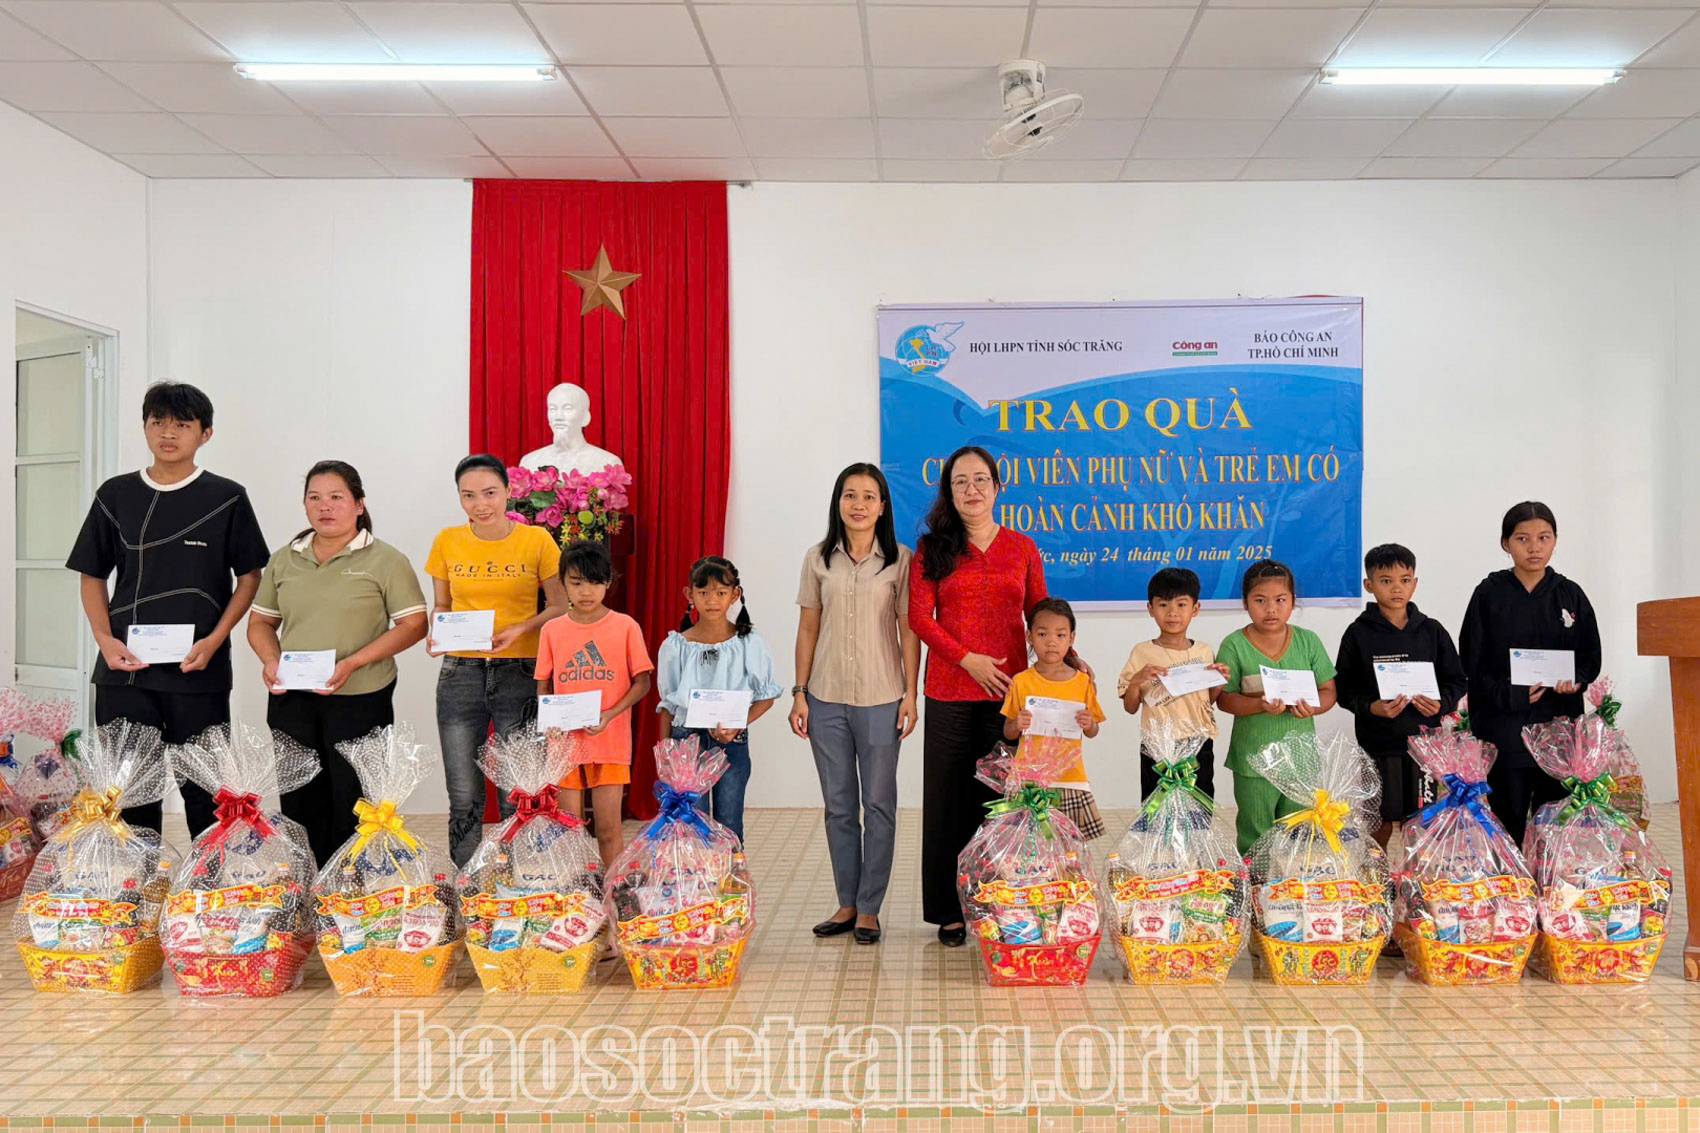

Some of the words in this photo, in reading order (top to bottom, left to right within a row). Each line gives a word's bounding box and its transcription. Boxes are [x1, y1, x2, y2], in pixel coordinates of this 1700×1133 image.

[1254, 330, 1278, 343] BÁO
[1280, 329, 1314, 343] CÔNG
[1316, 331, 1332, 342] AN
[970, 342, 991, 355] HỘI
[993, 342, 1025, 353] LHPN
[1026, 339, 1055, 352] TỈNH
[1058, 338, 1081, 352] SÓC
[1083, 339, 1123, 352] TRĂNG
[1172, 340, 1202, 351] Công
[1204, 341, 1218, 349] an
[1284, 346, 1304, 358] CHÍ
[1307, 347, 1339, 358] MINH
[988, 398, 1130, 432] TRAO
[1145, 387, 1254, 438] QUÀ
[997, 453, 1020, 493] ỘI
[1027, 449, 1081, 486] VIÊN
[1088, 456, 1134, 492] PHỤ
[1139, 449, 1174, 485] NỮ
[1178, 447, 1209, 484] VÀ
[1214, 446, 1260, 484] TRẺ
[1267, 454, 1301, 483] EM
[1307, 445, 1340, 482] CÓ
[1000, 496, 1065, 532] HOÀN
[1071, 495, 1136, 532] CẢNH
[1142, 494, 1193, 531] KHÓ
[1200, 494, 1266, 530] KHĂN
[1060, 547, 1096, 565] ngày
[1101, 547, 1119, 561] 24
[1127, 546, 1172, 564] tháng
[1175, 546, 1193, 561] 01
[1198, 547, 1231, 561] năm
[1236, 545, 1273, 561] 2025
[454, 563, 528, 574] GUCCI
[558, 666, 615, 684] adidas
